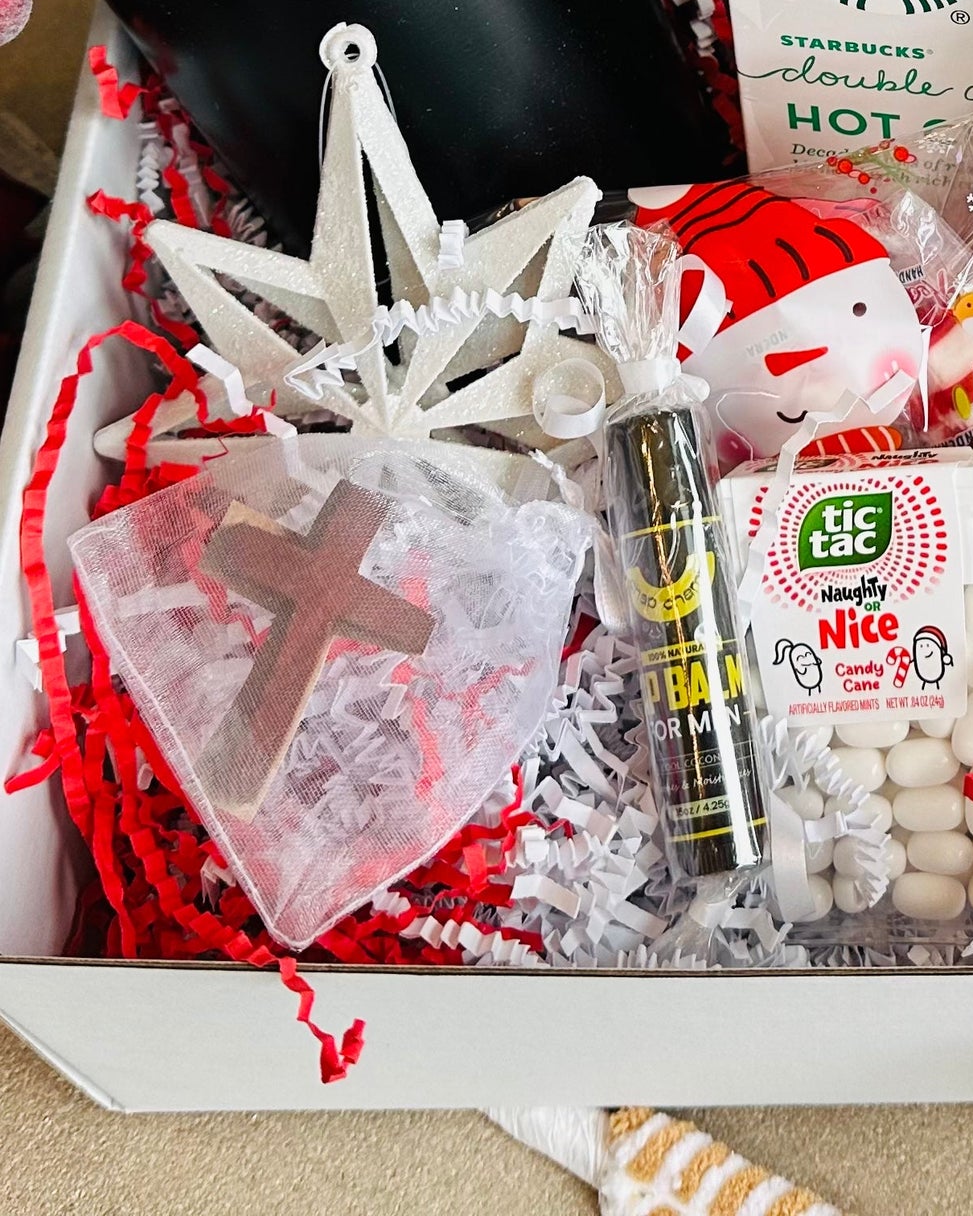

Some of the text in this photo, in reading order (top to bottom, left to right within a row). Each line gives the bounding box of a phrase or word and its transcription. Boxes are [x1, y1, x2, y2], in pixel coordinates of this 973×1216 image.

[780, 34, 926, 60] STARBUCKS
[738, 55, 954, 97] double
[787, 102, 900, 139] HOT
[822, 500, 877, 533] tic
[809, 531, 877, 557] tac
[864, 601, 881, 612] OR
[818, 607, 899, 650] Nice
[835, 660, 884, 678] Candy
[843, 679, 880, 693] Cane
[789, 700, 828, 715] ARTIFICIALLY
[828, 699, 860, 712] FLAVORED
[860, 698, 879, 710] MINTS
[886, 697, 897, 709] NET
[897, 696, 909, 708] WT
[920, 695, 929, 707] OZ
